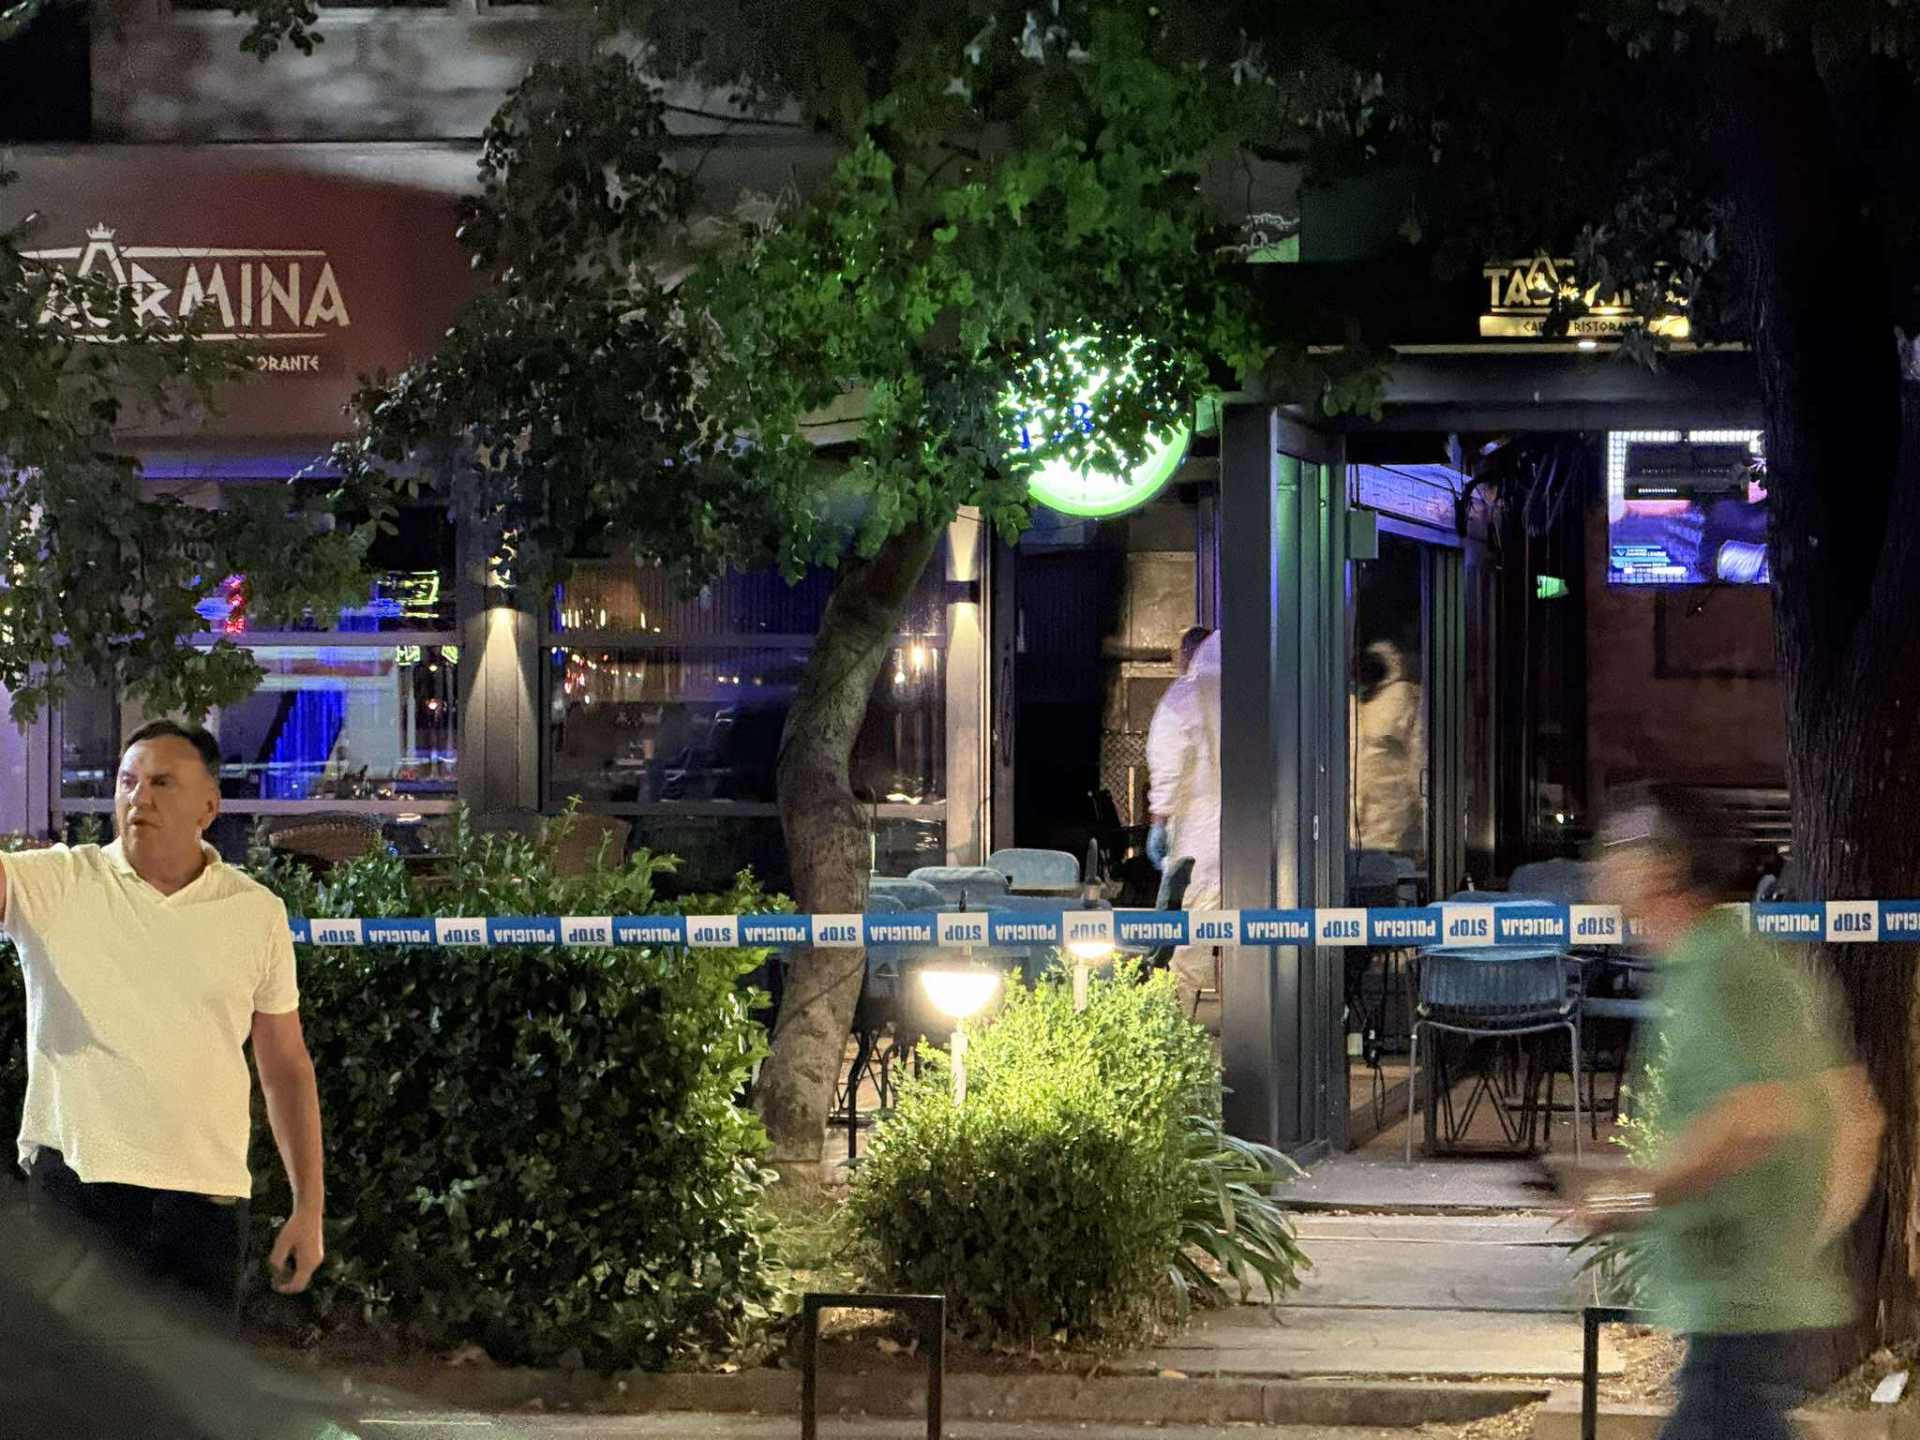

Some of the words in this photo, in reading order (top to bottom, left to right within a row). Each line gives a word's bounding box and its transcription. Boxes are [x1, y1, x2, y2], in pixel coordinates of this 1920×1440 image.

[318, 929, 355, 942] STOP
[368, 929, 430, 942] POLICIJA
[443, 929, 481, 942] STOP
[493, 928, 555, 942] POLICIJA
[568, 928, 606, 942] STOP
[619, 927, 681, 941] POLICIJA
[694, 927, 732, 941] STOP
[744, 927, 806, 941] POLICIJA
[819, 926, 856, 941] STOP
[870, 925, 932, 940] POLICIJA
[944, 924, 982, 940] STOP
[995, 924, 1057, 940] POLICIJA
[1069, 923, 1107, 939] STOP
[1120, 923, 1182, 939] POLICIJA
[1195, 922, 1233, 939] STOP
[1247, 921, 1309, 938] POLICIJA
[1322, 920, 1360, 938] STOP
[1374, 920, 1436, 936] POLICIJA
[1449, 919, 1488, 936] STOP
[1501, 918, 1564, 935] POLICIJA
[1577, 918, 1615, 935] STOP
[1757, 915, 1820, 932] POLICIJA
[1833, 913, 1872, 931] STOP
